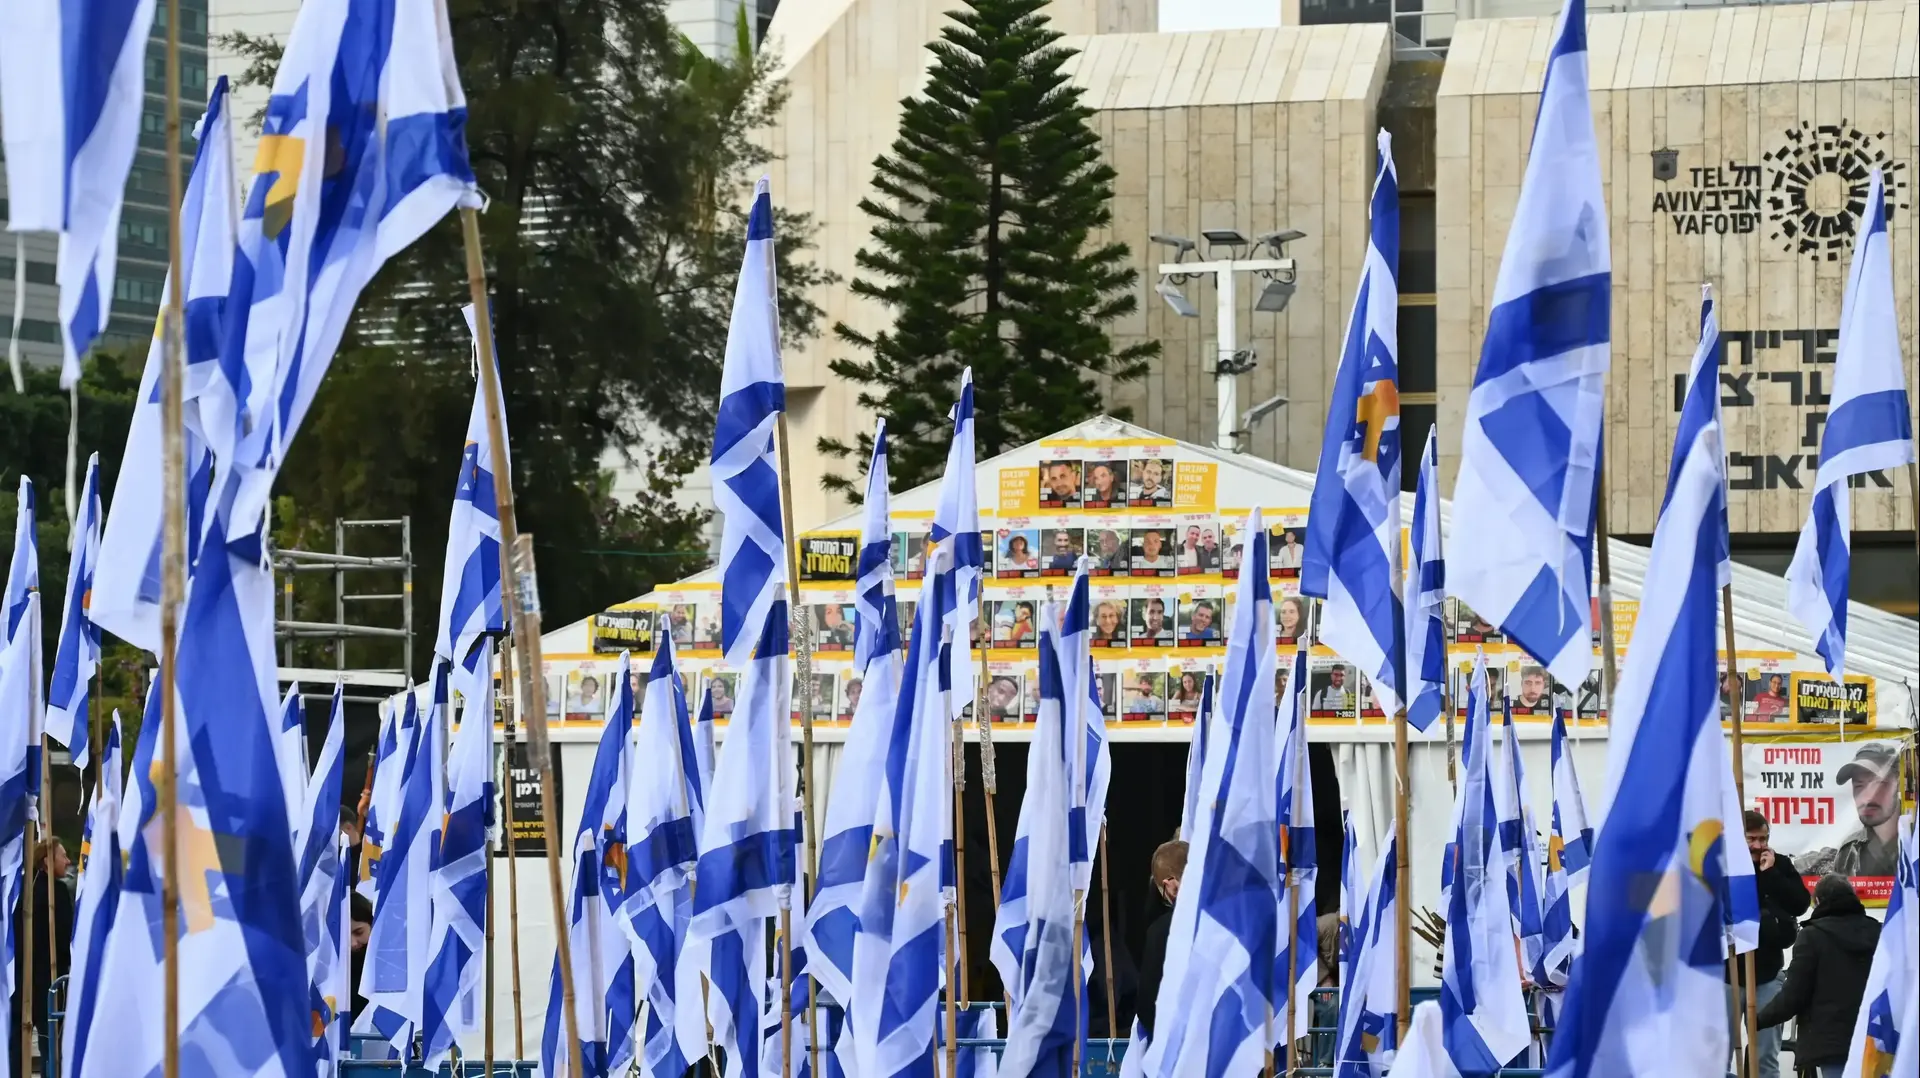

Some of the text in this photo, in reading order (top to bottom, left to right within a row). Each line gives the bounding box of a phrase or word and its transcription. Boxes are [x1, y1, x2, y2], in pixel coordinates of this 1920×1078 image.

[1689, 166, 1729, 188] TEL
[1729, 160, 1762, 187] תל
[1652, 191, 1704, 212] AVIV
[1705, 189, 1761, 211] אביב
[1672, 214, 1729, 235] YAFO
[1729, 212, 1762, 234] יפו
[1178, 464, 1208, 473] BRING
[1178, 474, 1203, 483] THEM
[1177, 484, 1202, 492] HOME
[1177, 494, 1196, 502] NOW
[1612, 613, 1632, 622] HEM
[1802, 683, 1863, 701] לא משאירים
[1830, 698, 1852, 712] אחד
[1853, 701, 1868, 714] אף
[1764, 748, 1822, 765] מחזירים
[1761, 771, 1824, 789] את איתי
[1754, 797, 1835, 825] הביתה
